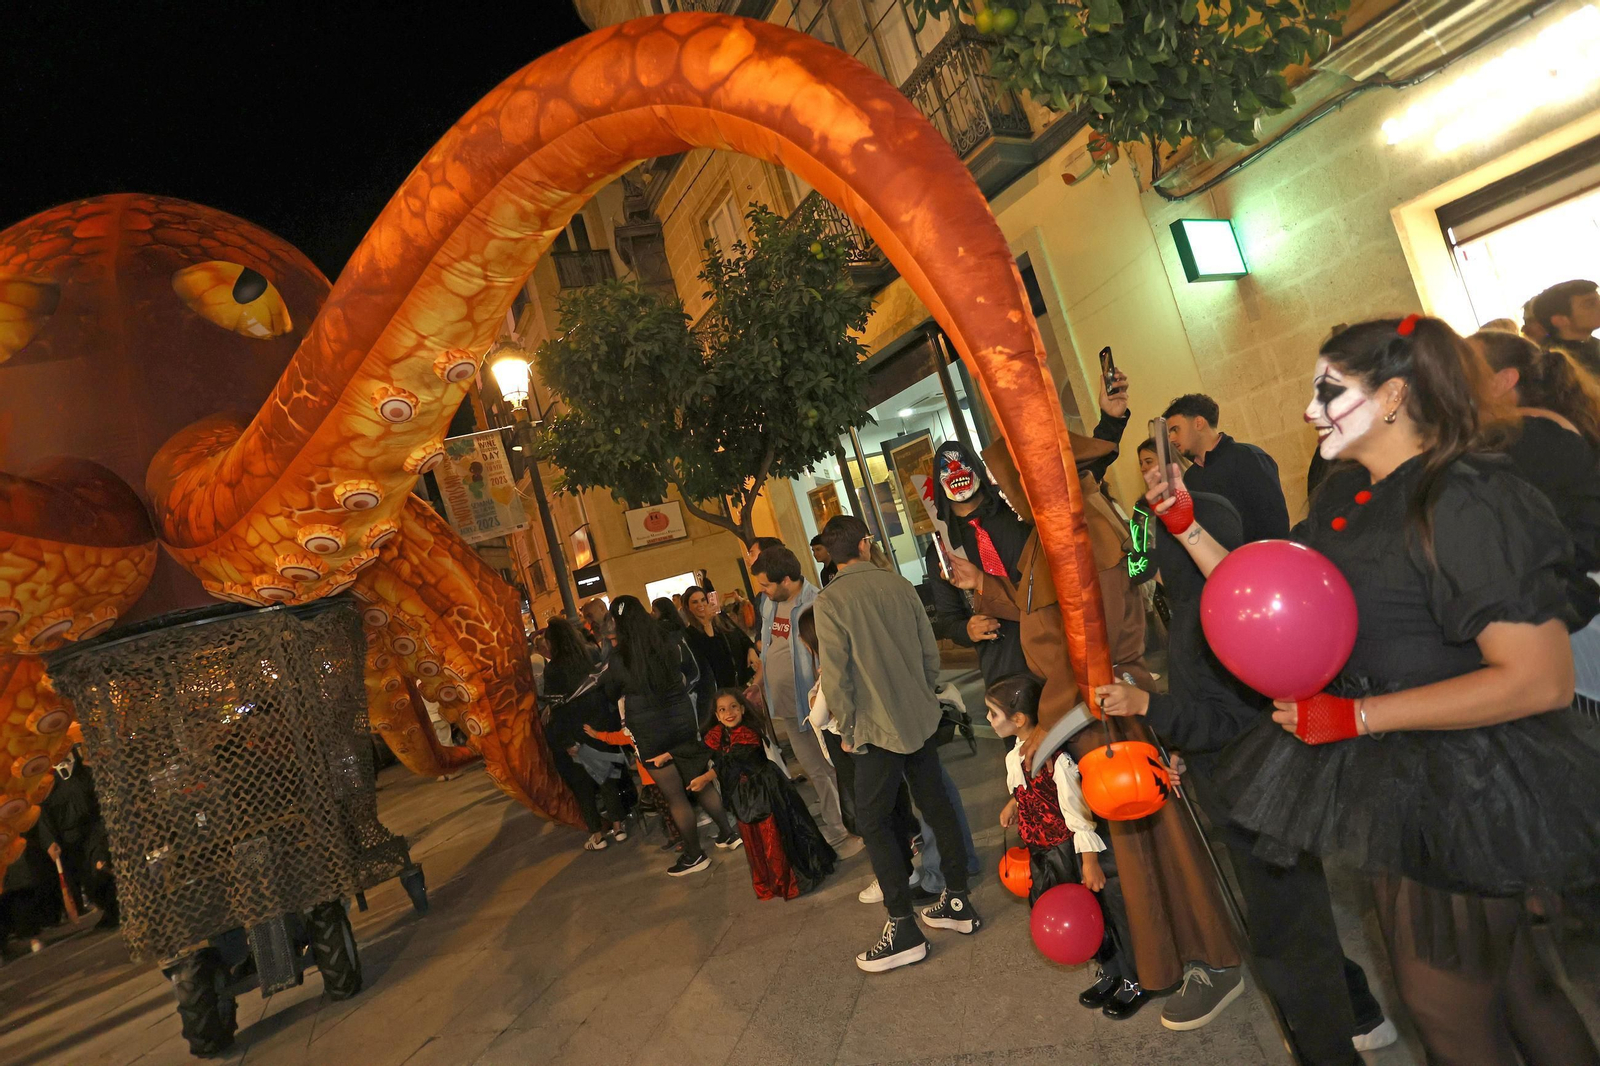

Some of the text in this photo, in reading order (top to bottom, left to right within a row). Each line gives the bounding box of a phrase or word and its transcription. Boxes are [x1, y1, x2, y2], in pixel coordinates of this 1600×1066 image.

[477, 439, 497, 449] WINE
[481, 450, 500, 462] DAY
[443, 475, 475, 528] ENOTURISMO
[476, 516, 500, 530] 2025
